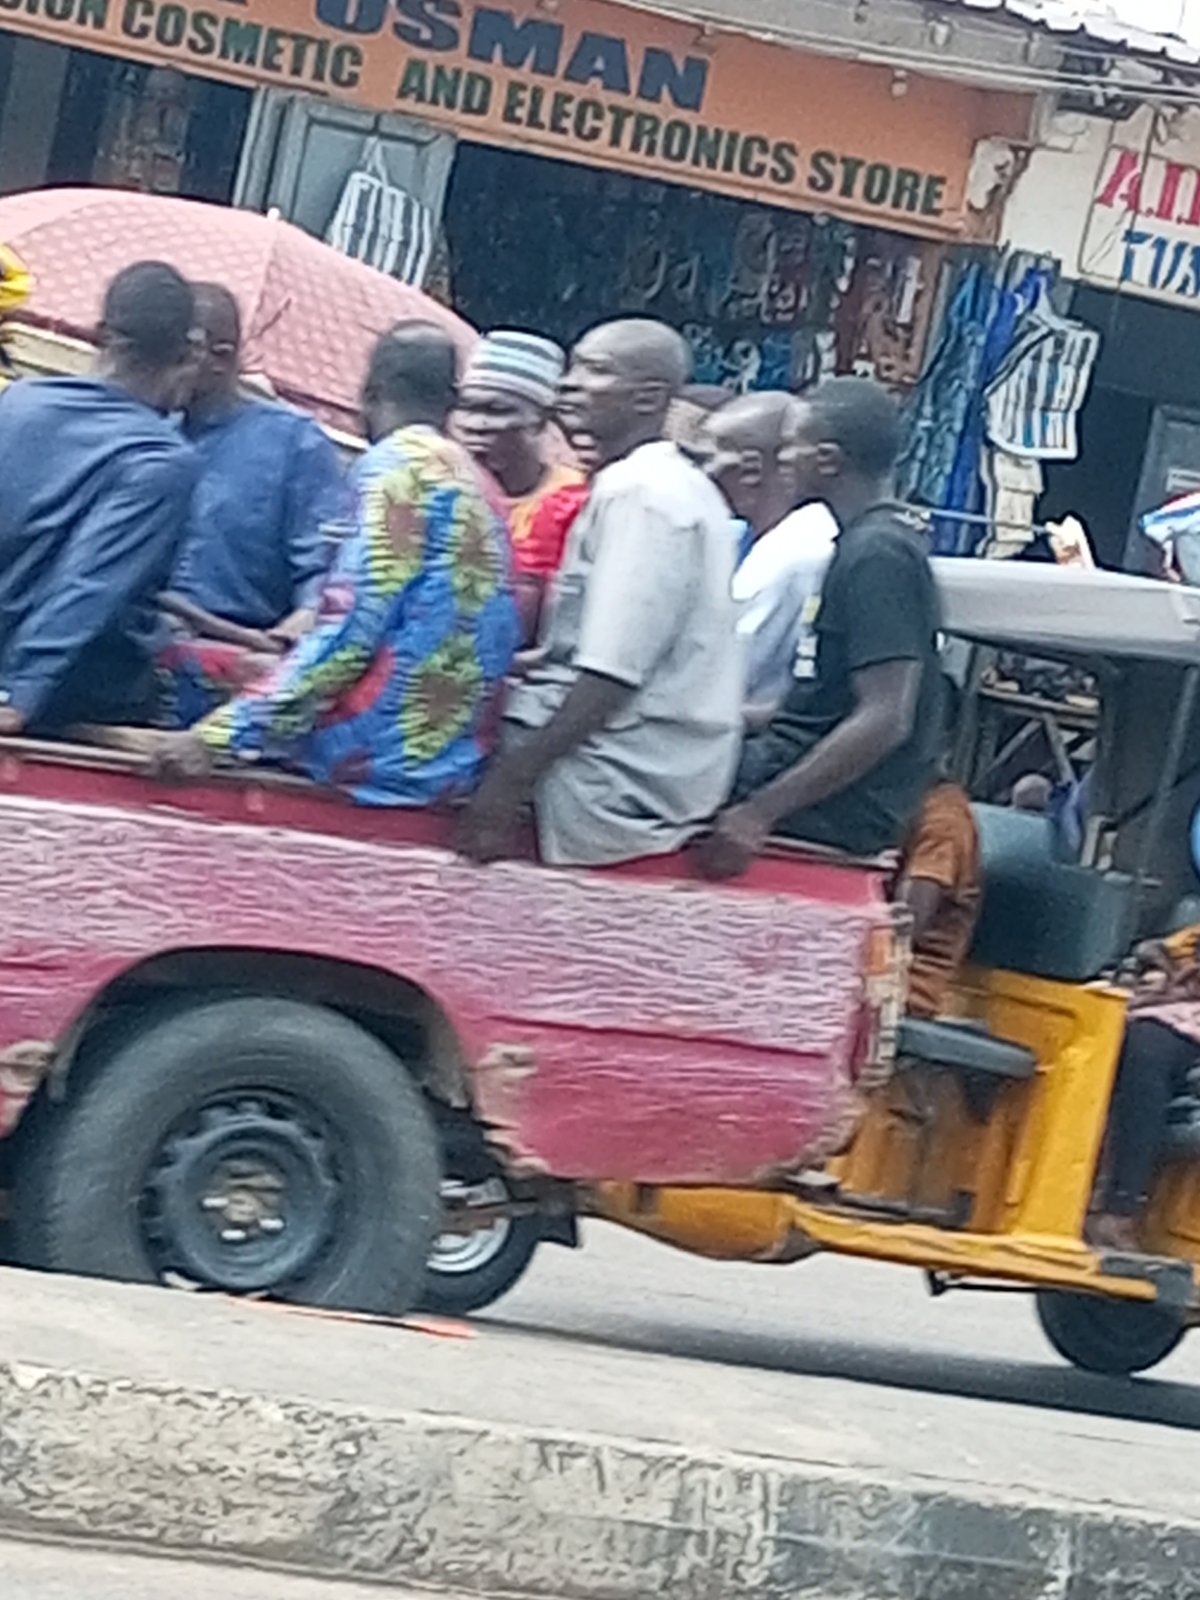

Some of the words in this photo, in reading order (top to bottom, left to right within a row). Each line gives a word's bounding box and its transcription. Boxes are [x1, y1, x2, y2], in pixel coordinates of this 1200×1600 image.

[121, 0, 362, 88] COSMETIC
[397, 58, 492, 116] AND
[502, 80, 798, 184] ELECTRONICS
[808, 151, 947, 217] STORE
